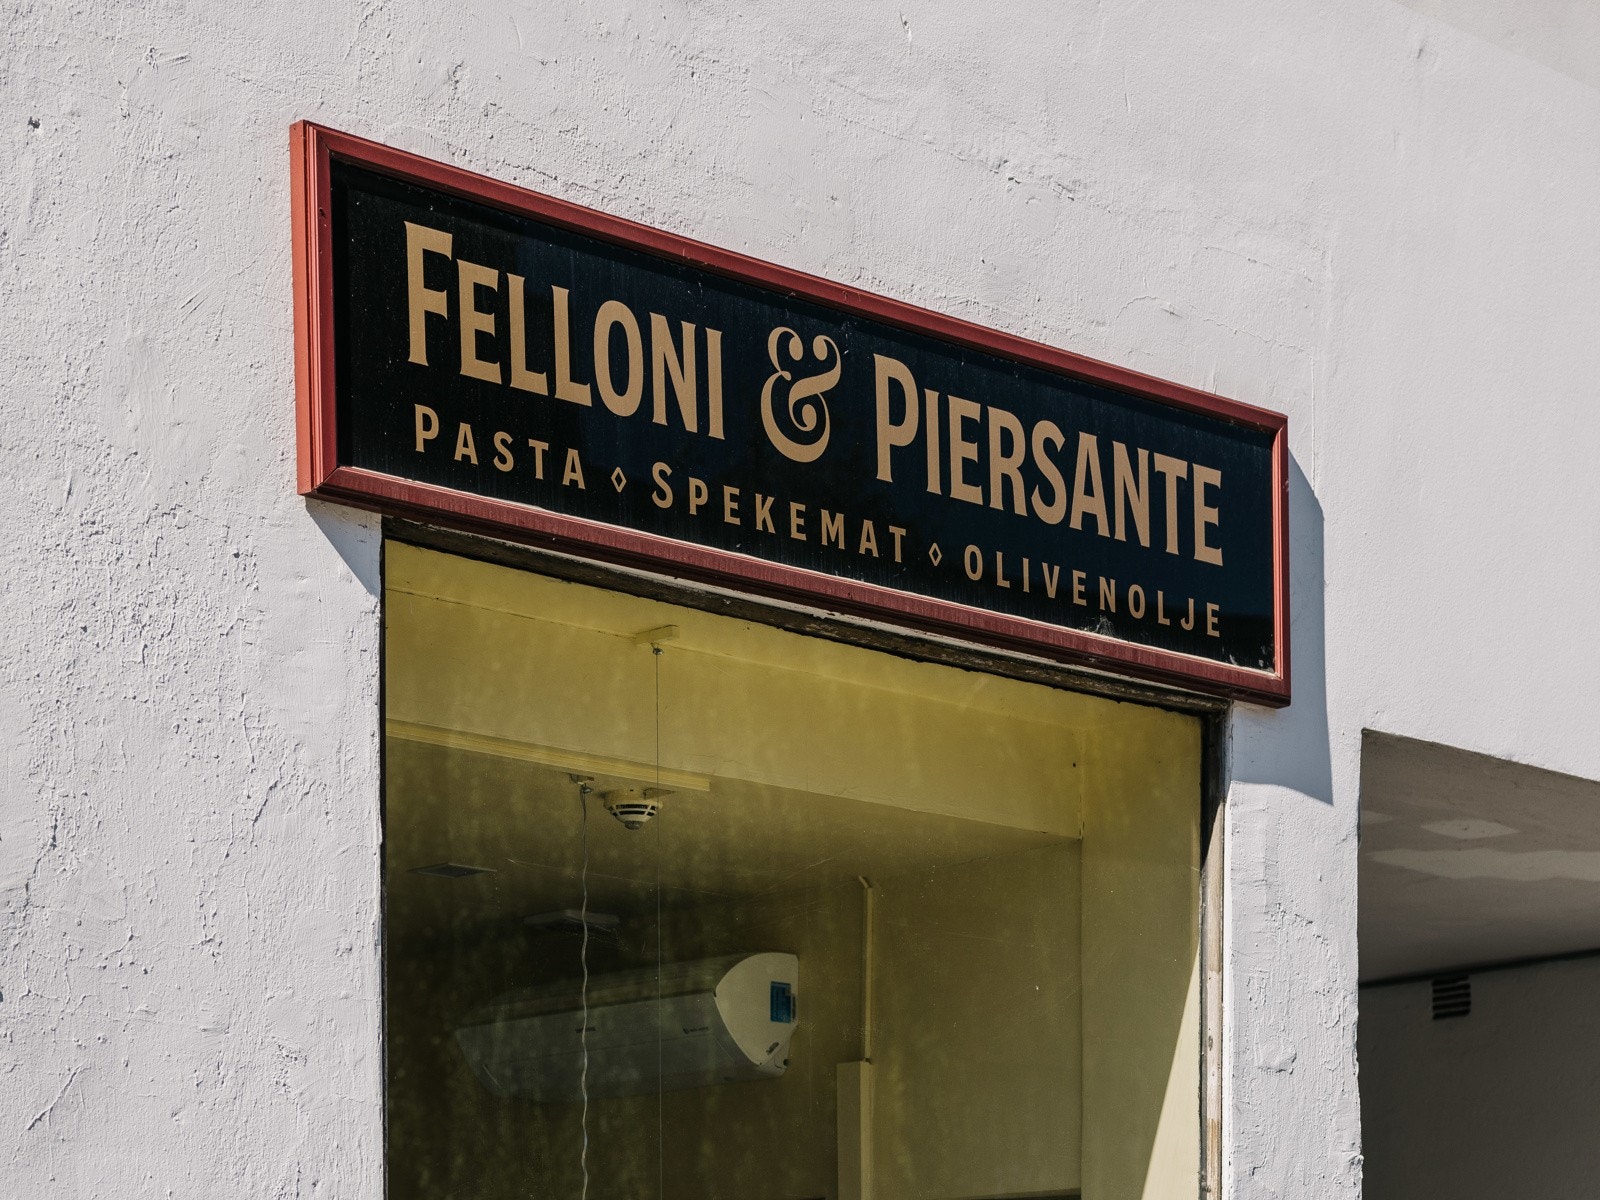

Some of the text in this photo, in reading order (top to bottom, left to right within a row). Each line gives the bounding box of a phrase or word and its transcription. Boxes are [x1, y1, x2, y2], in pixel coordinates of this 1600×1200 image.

[404, 221, 1223, 566] FELLONI & PIERSANTE
[414, 404, 1221, 637] PASTA SPEKEMAT OLIVENOLJE
